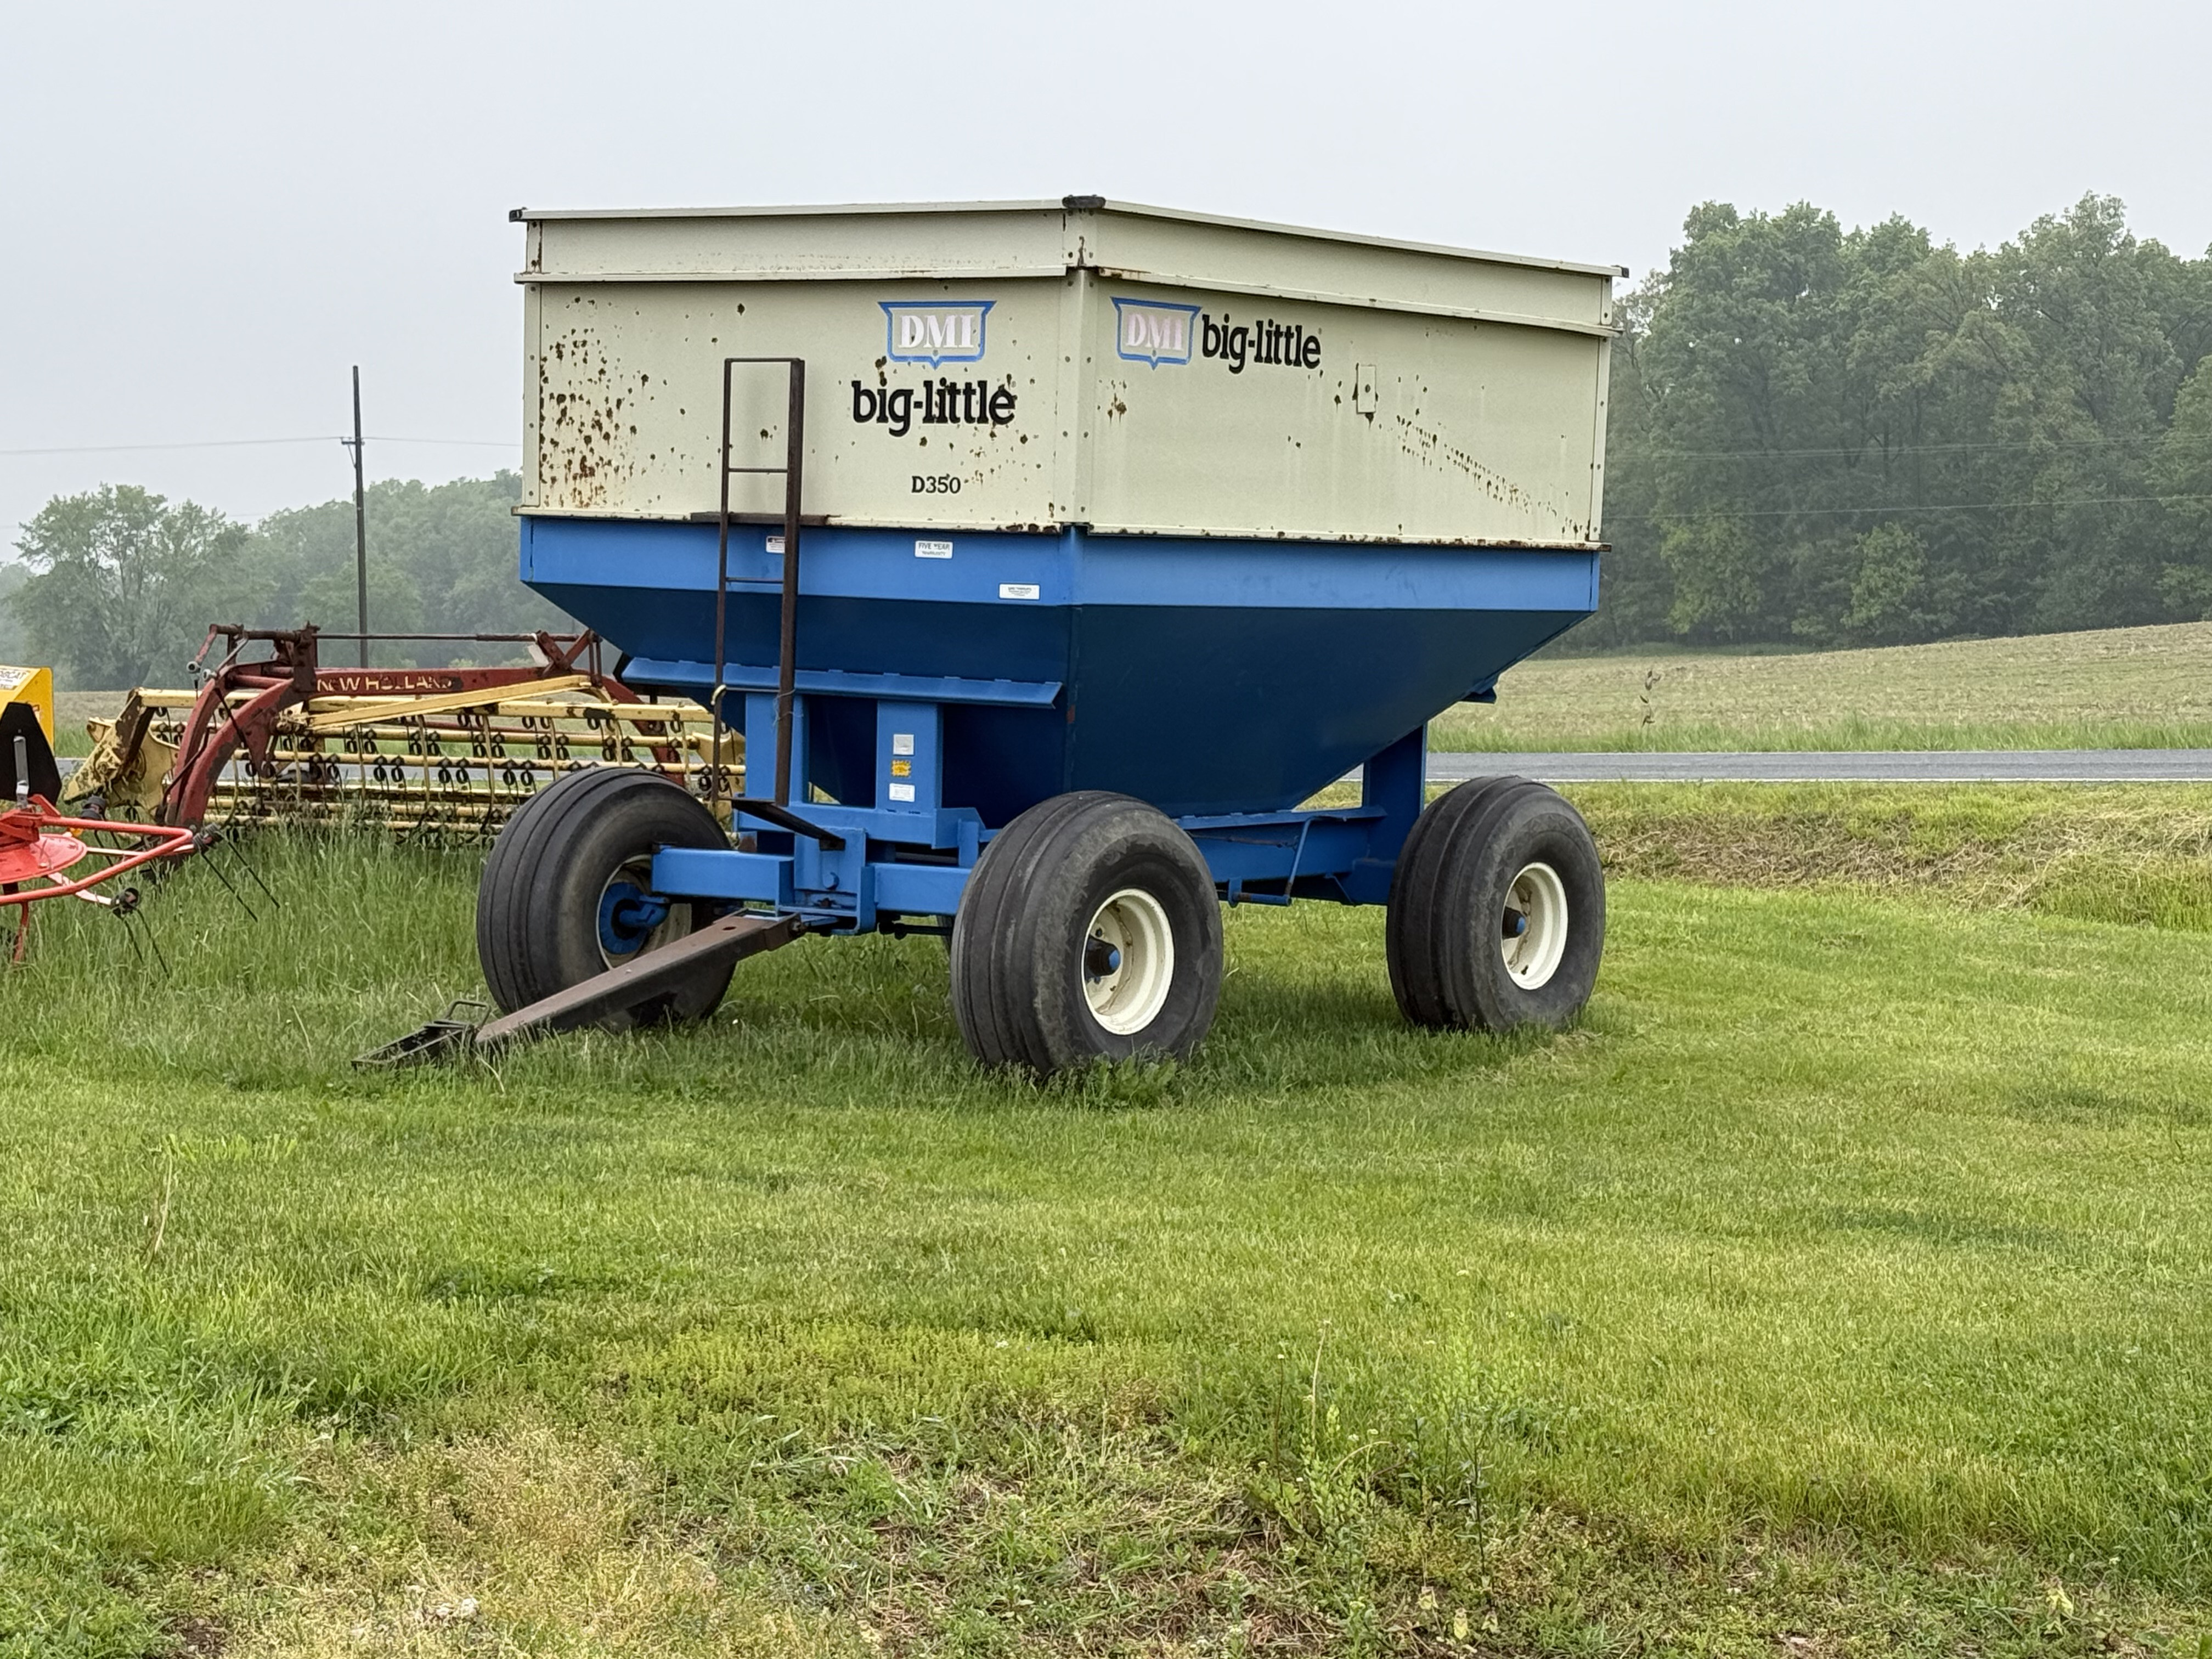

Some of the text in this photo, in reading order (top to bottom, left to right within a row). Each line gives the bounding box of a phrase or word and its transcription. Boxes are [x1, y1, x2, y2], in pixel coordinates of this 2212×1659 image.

[898, 315, 974, 348] DMI
[1125, 313, 1184, 351] DMI
[1202, 313, 1321, 374] big-little
[851, 377, 1015, 437] big-little
[912, 475, 961, 493] D350
[318, 677, 360, 691] NW
